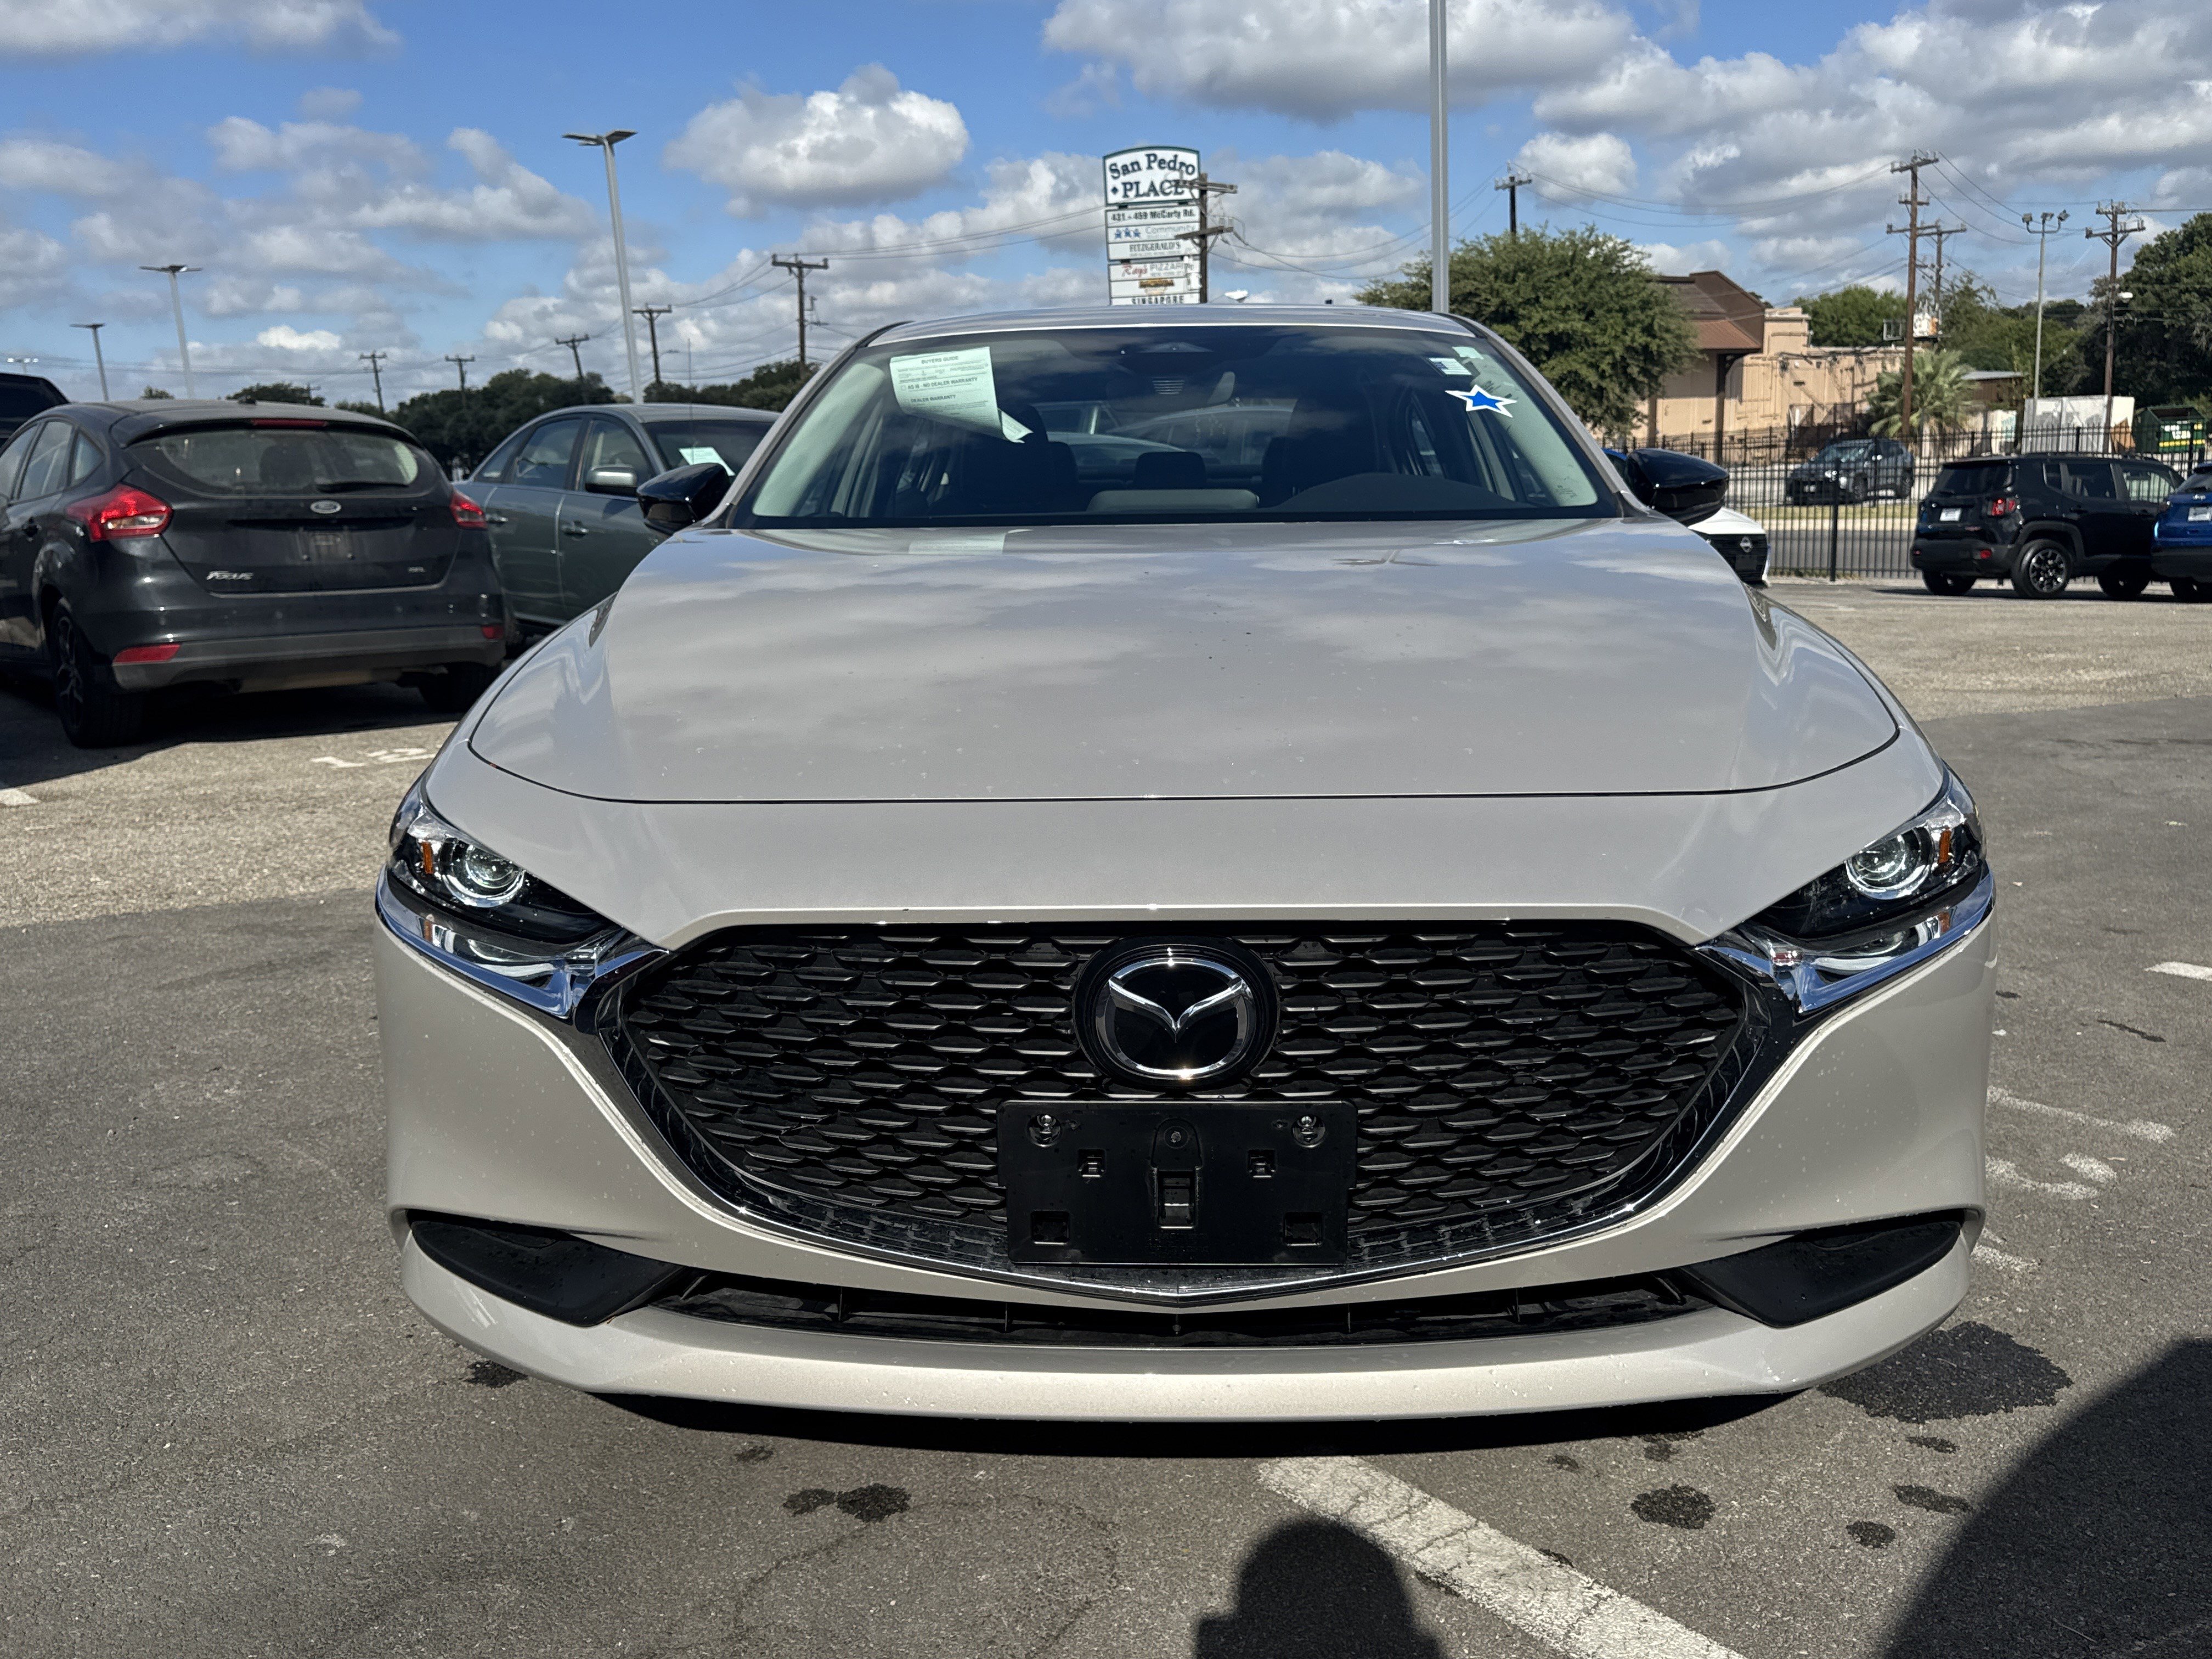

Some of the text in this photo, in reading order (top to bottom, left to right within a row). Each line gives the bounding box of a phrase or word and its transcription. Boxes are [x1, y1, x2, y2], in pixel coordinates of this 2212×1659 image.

[1109, 153, 1195, 179] San Pedro
[1122, 179, 1184, 198] PLACE
[1150, 210, 1181, 219] McCarty
[1145, 225, 1196, 234] Community
